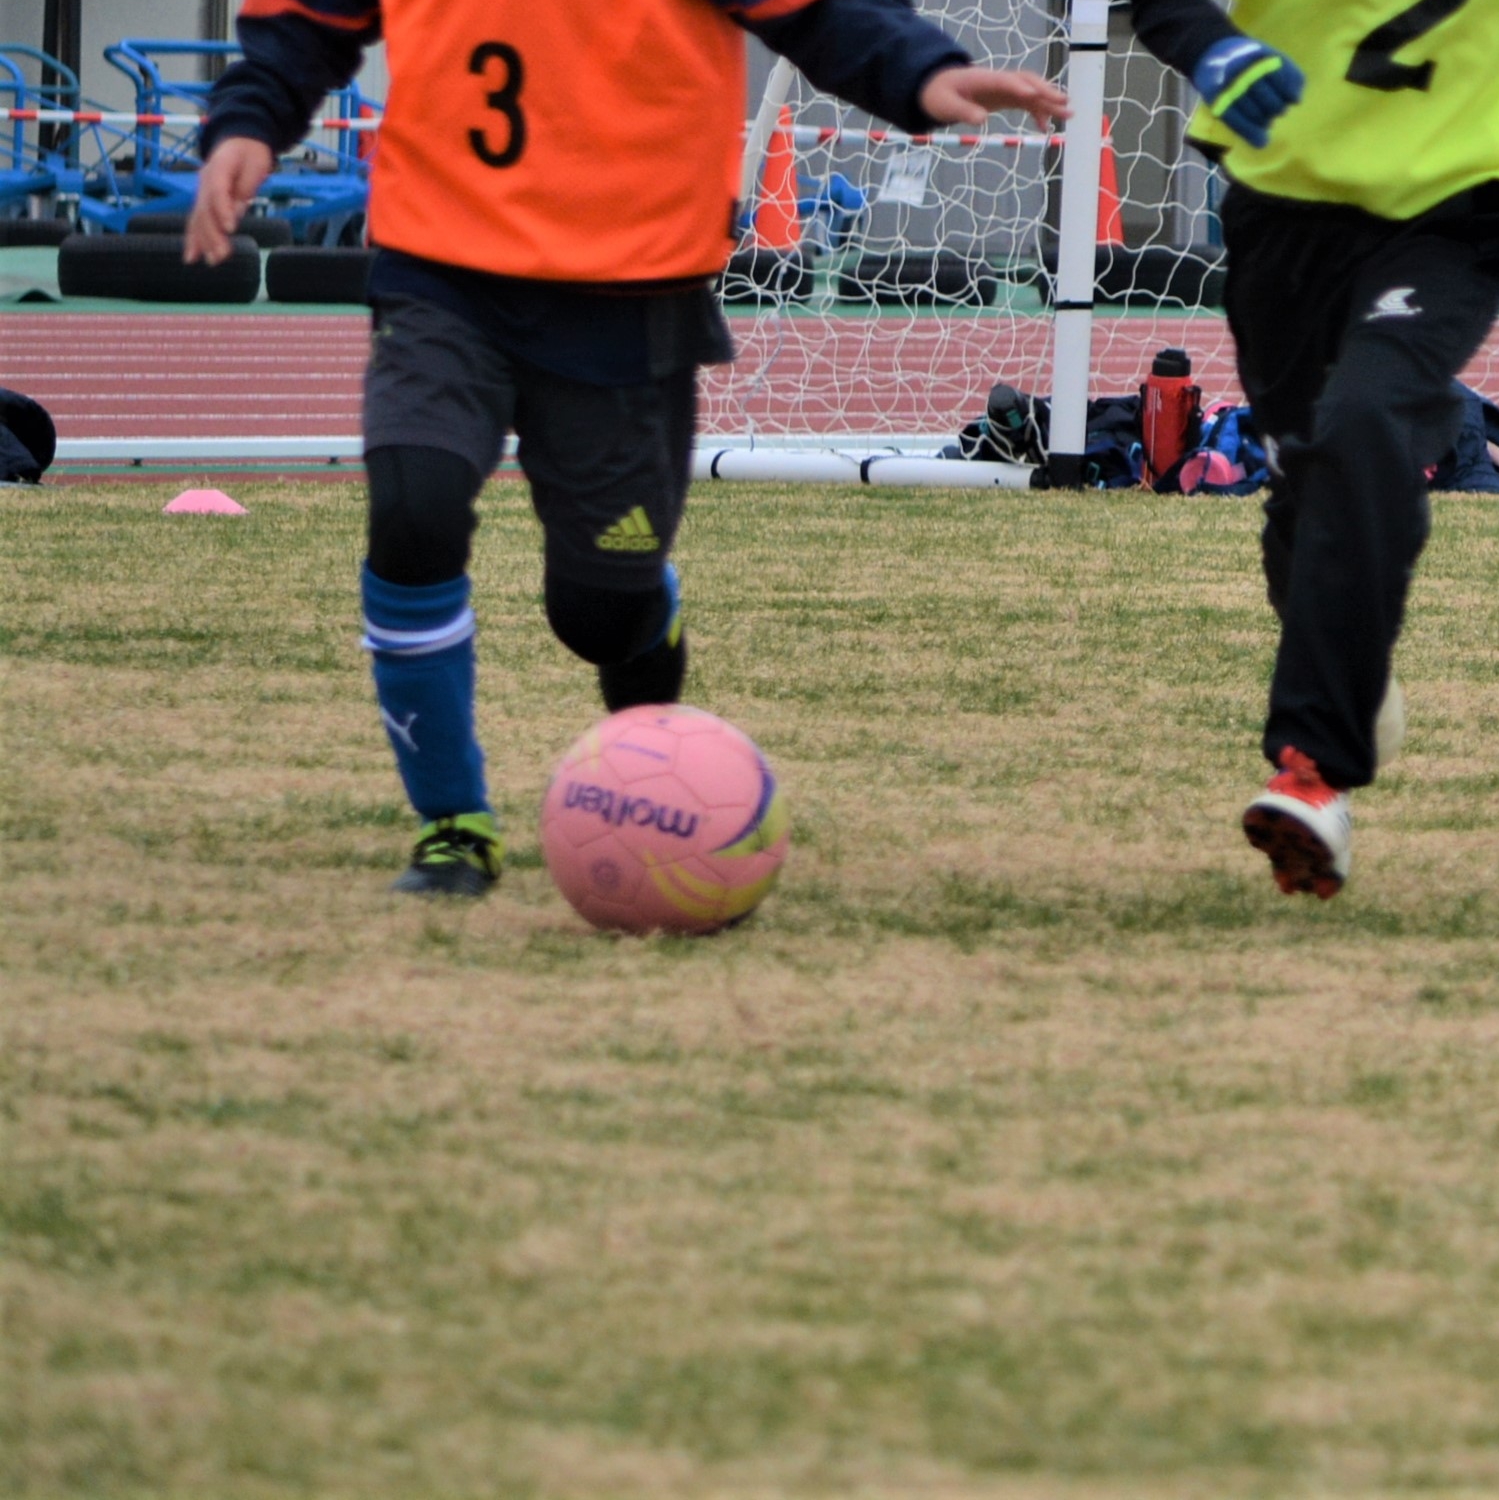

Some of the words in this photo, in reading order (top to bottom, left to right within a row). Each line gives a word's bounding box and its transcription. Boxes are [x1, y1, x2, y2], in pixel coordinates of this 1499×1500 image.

[468, 41, 527, 169] 3
[594, 534, 660, 552] adidas
[564, 781, 700, 838] molten
